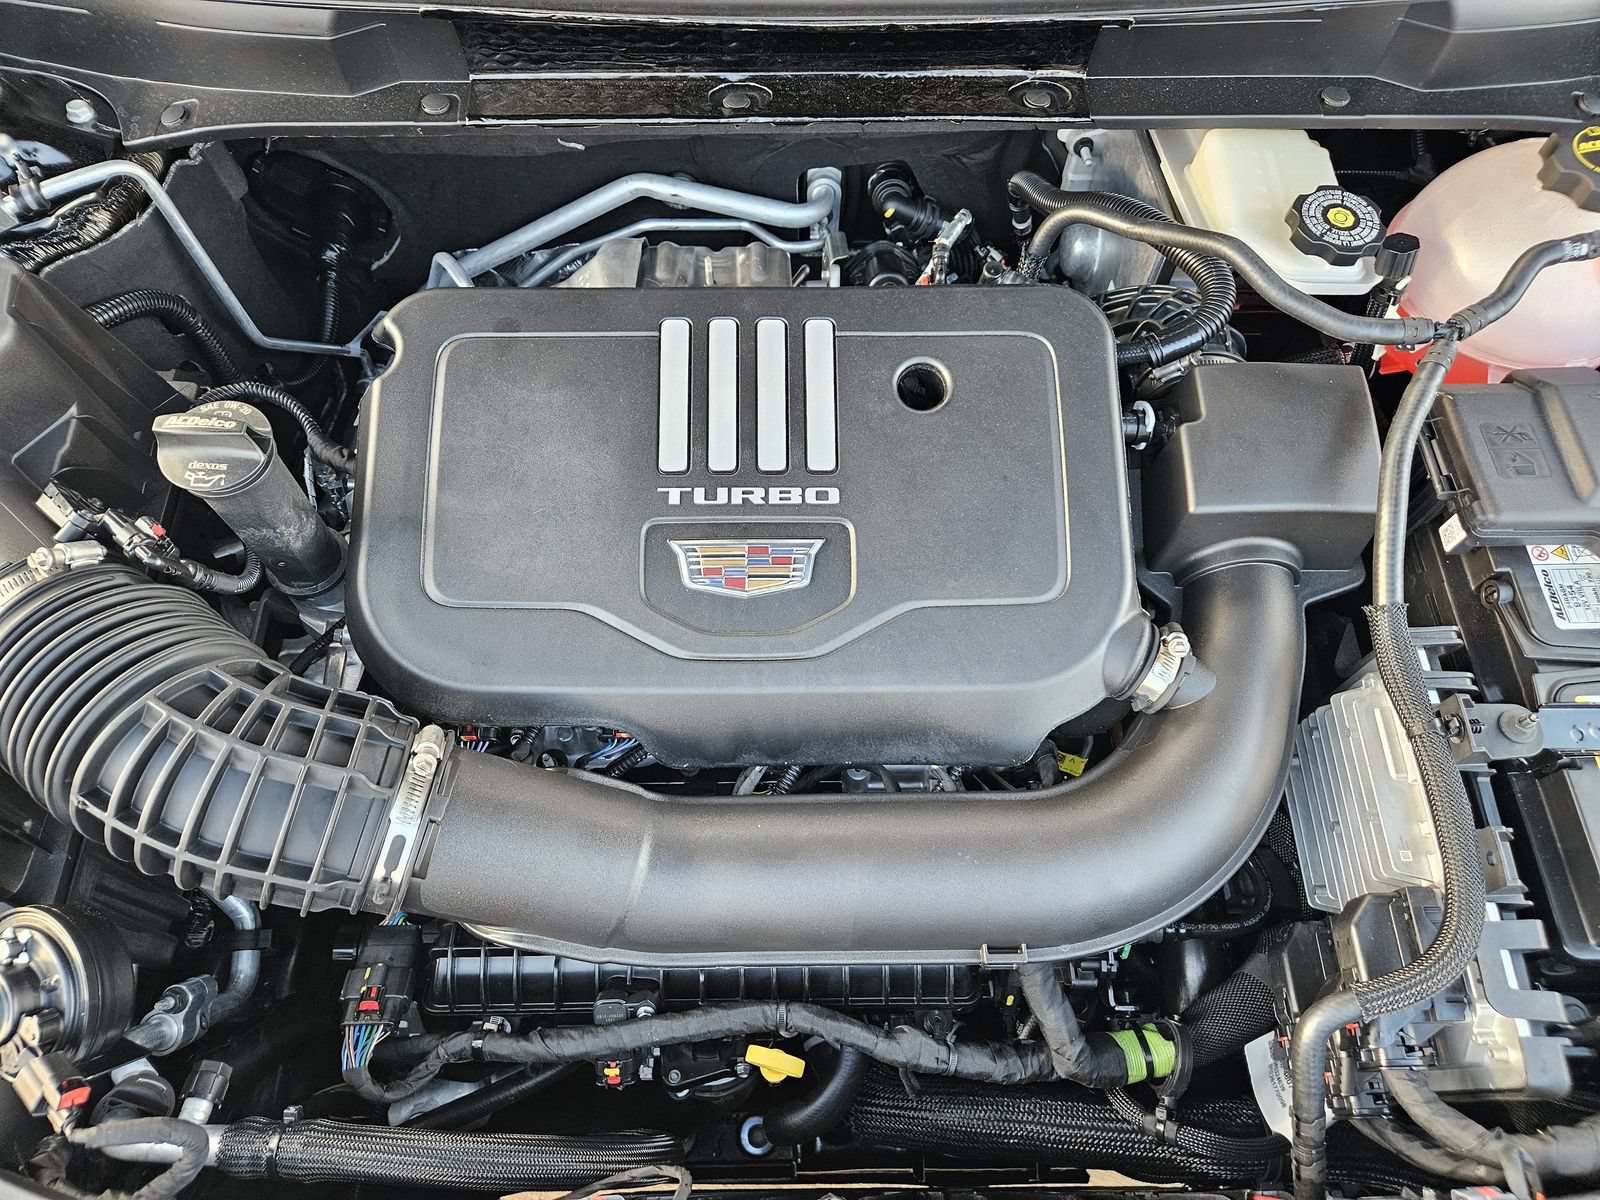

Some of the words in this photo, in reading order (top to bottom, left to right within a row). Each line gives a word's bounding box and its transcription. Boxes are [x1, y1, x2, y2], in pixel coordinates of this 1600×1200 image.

[200, 401, 219, 413] SAE
[224, 400, 252, 415] 0W-20
[163, 416, 237, 429] ACDelco
[188, 461, 229, 471] dexos
[656, 487, 840, 505] TURBO
[1541, 569, 1567, 621] ACDelco
[1566, 584, 1581, 608] 9354
